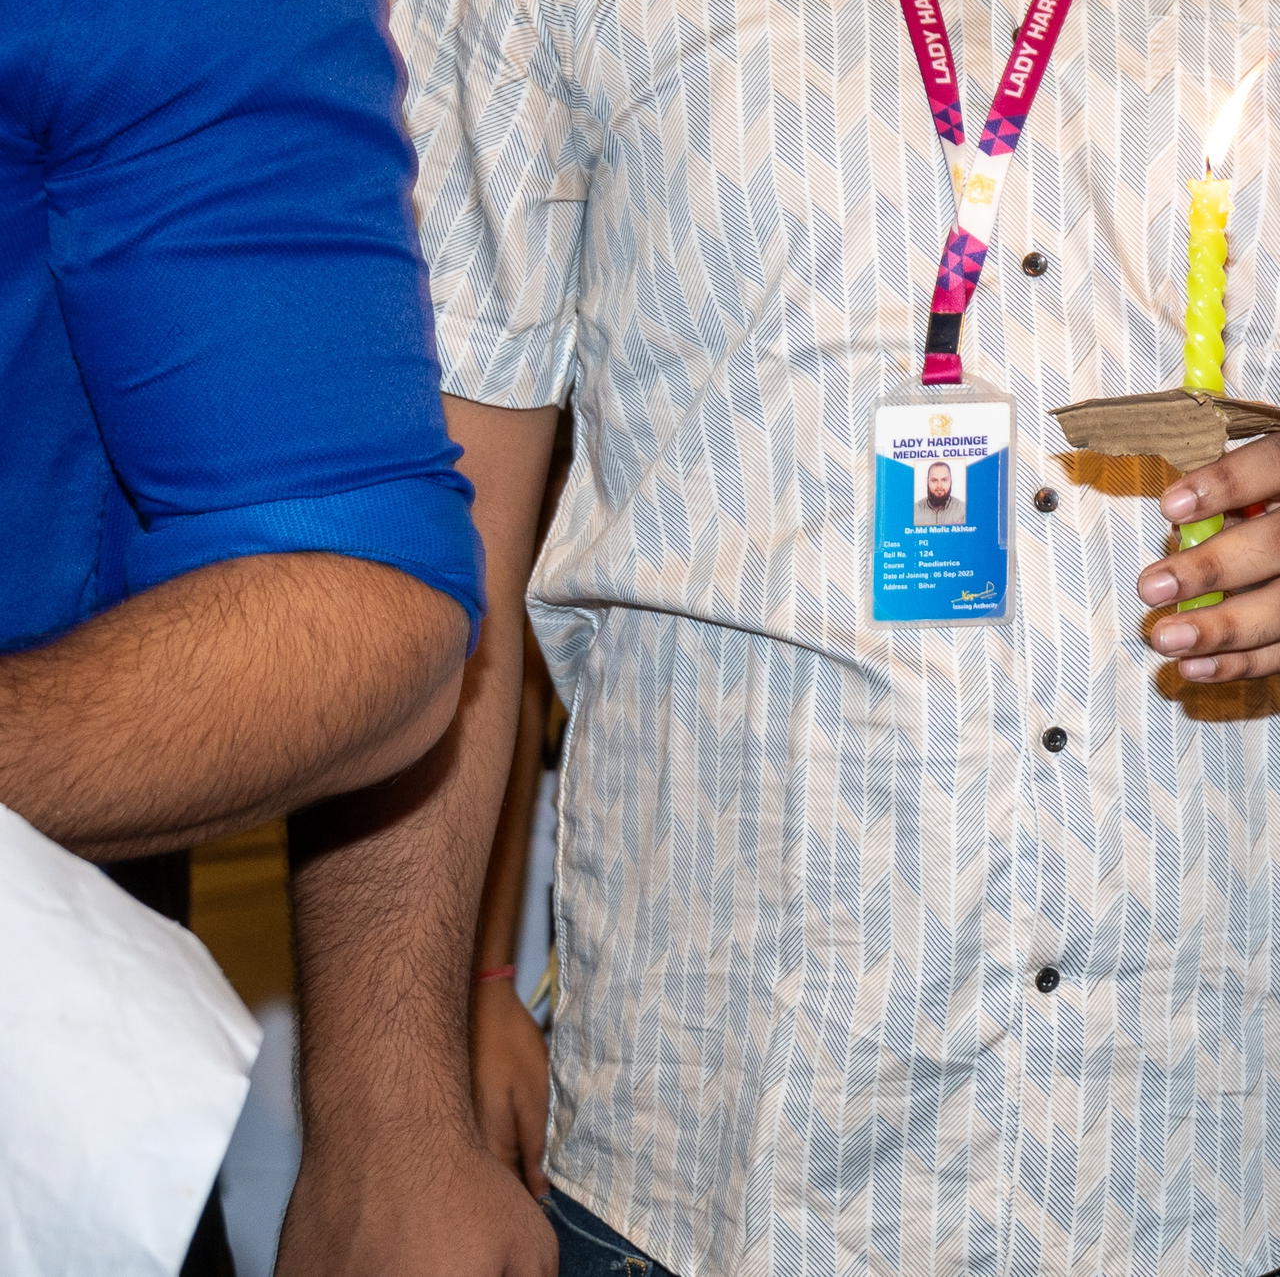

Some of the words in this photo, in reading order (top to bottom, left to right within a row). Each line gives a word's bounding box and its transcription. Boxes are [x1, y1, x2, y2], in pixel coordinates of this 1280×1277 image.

[923, 30, 951, 84] LADY
[1004, 43, 1038, 99] LADY
[893, 438, 923, 448] LADY
[927, 435, 988, 447] HARDINGE
[893, 449, 940, 459] MEDICAL
[942, 447, 988, 458] COLLEGE
